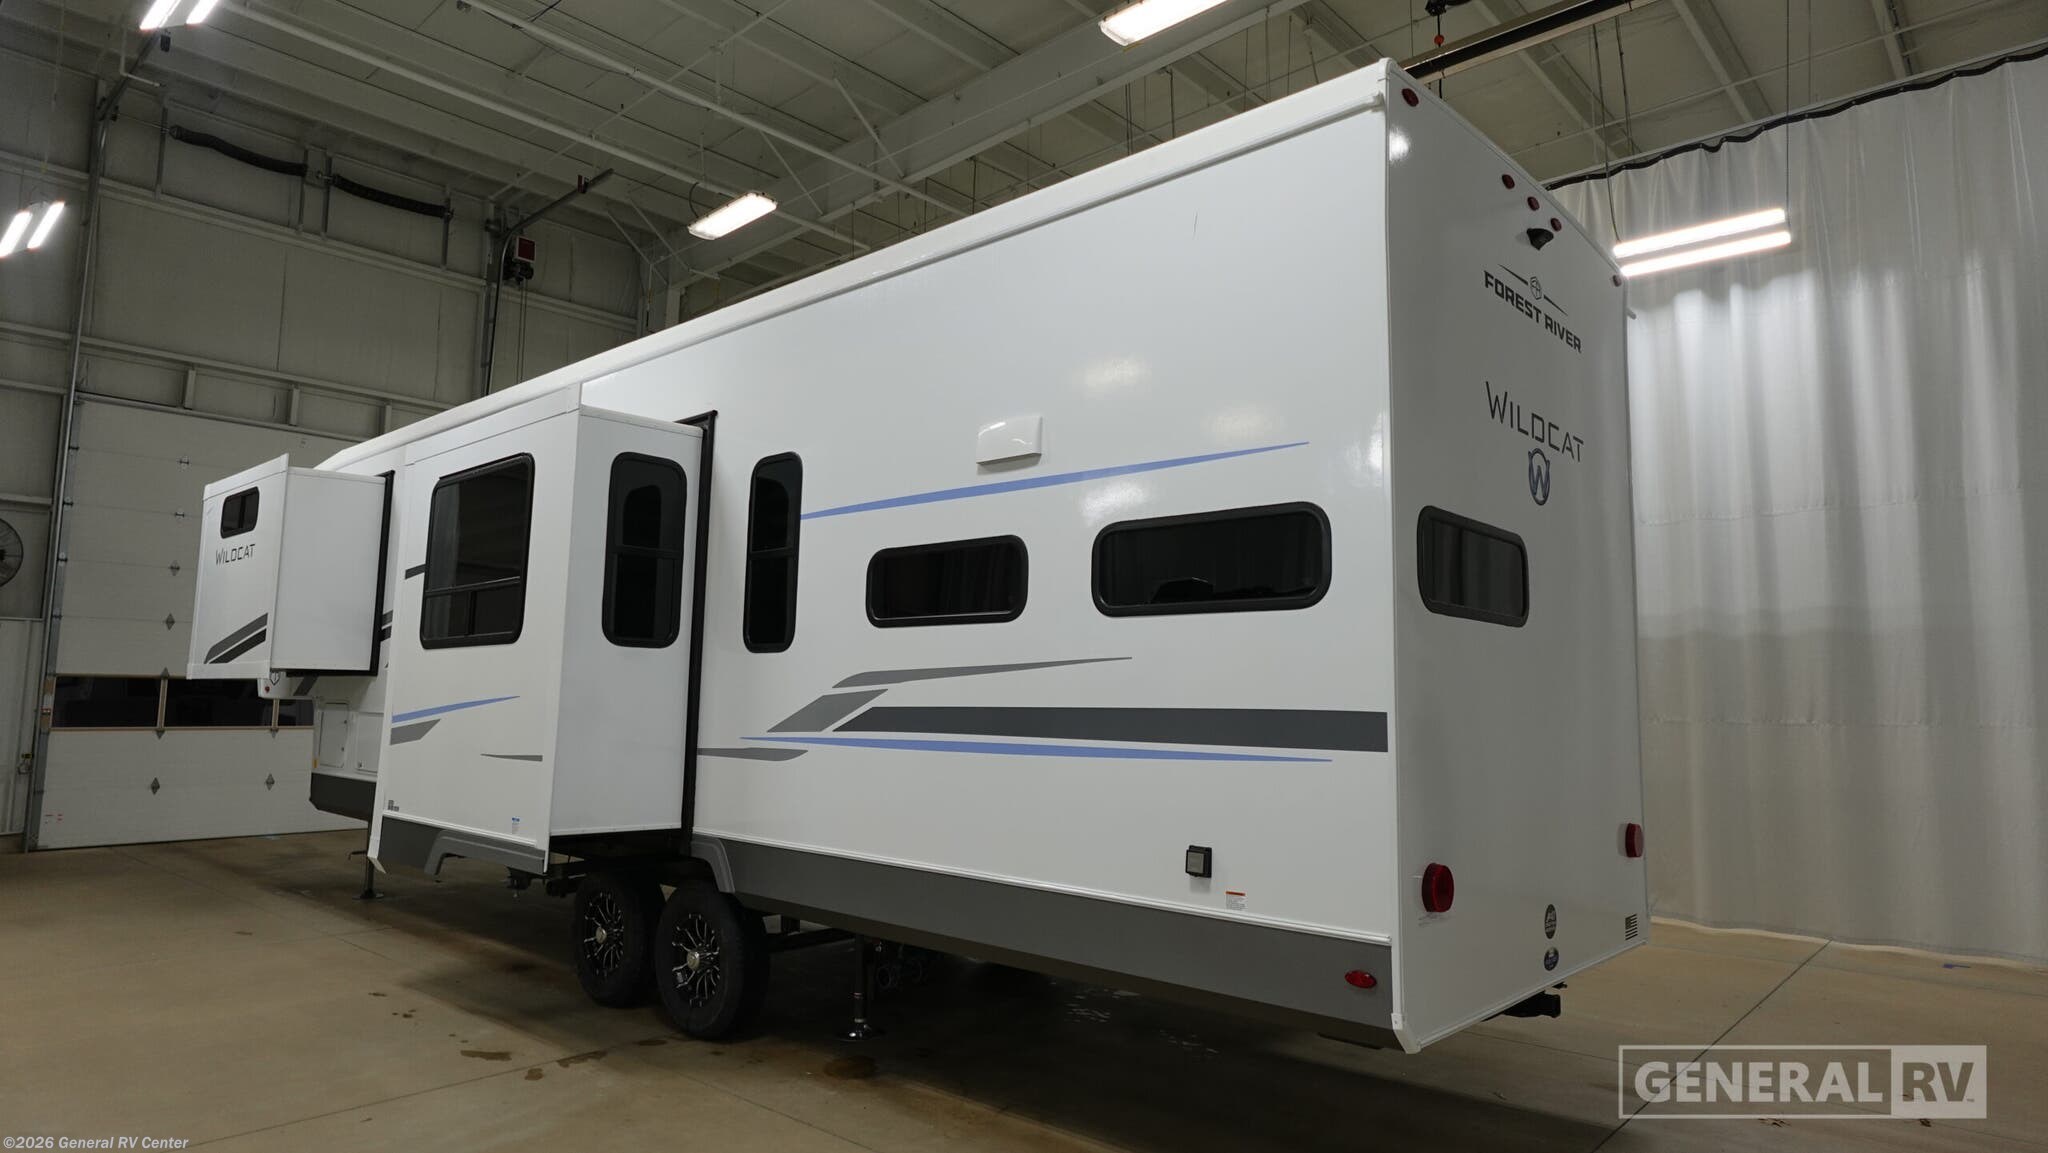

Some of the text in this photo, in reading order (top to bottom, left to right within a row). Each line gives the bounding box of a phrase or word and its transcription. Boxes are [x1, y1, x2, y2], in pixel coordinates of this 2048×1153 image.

[1484, 270, 1582, 353] FOREST RIVER
[1485, 380, 1584, 462] WILDCAT
[215, 543, 255, 565] WILDCAT
